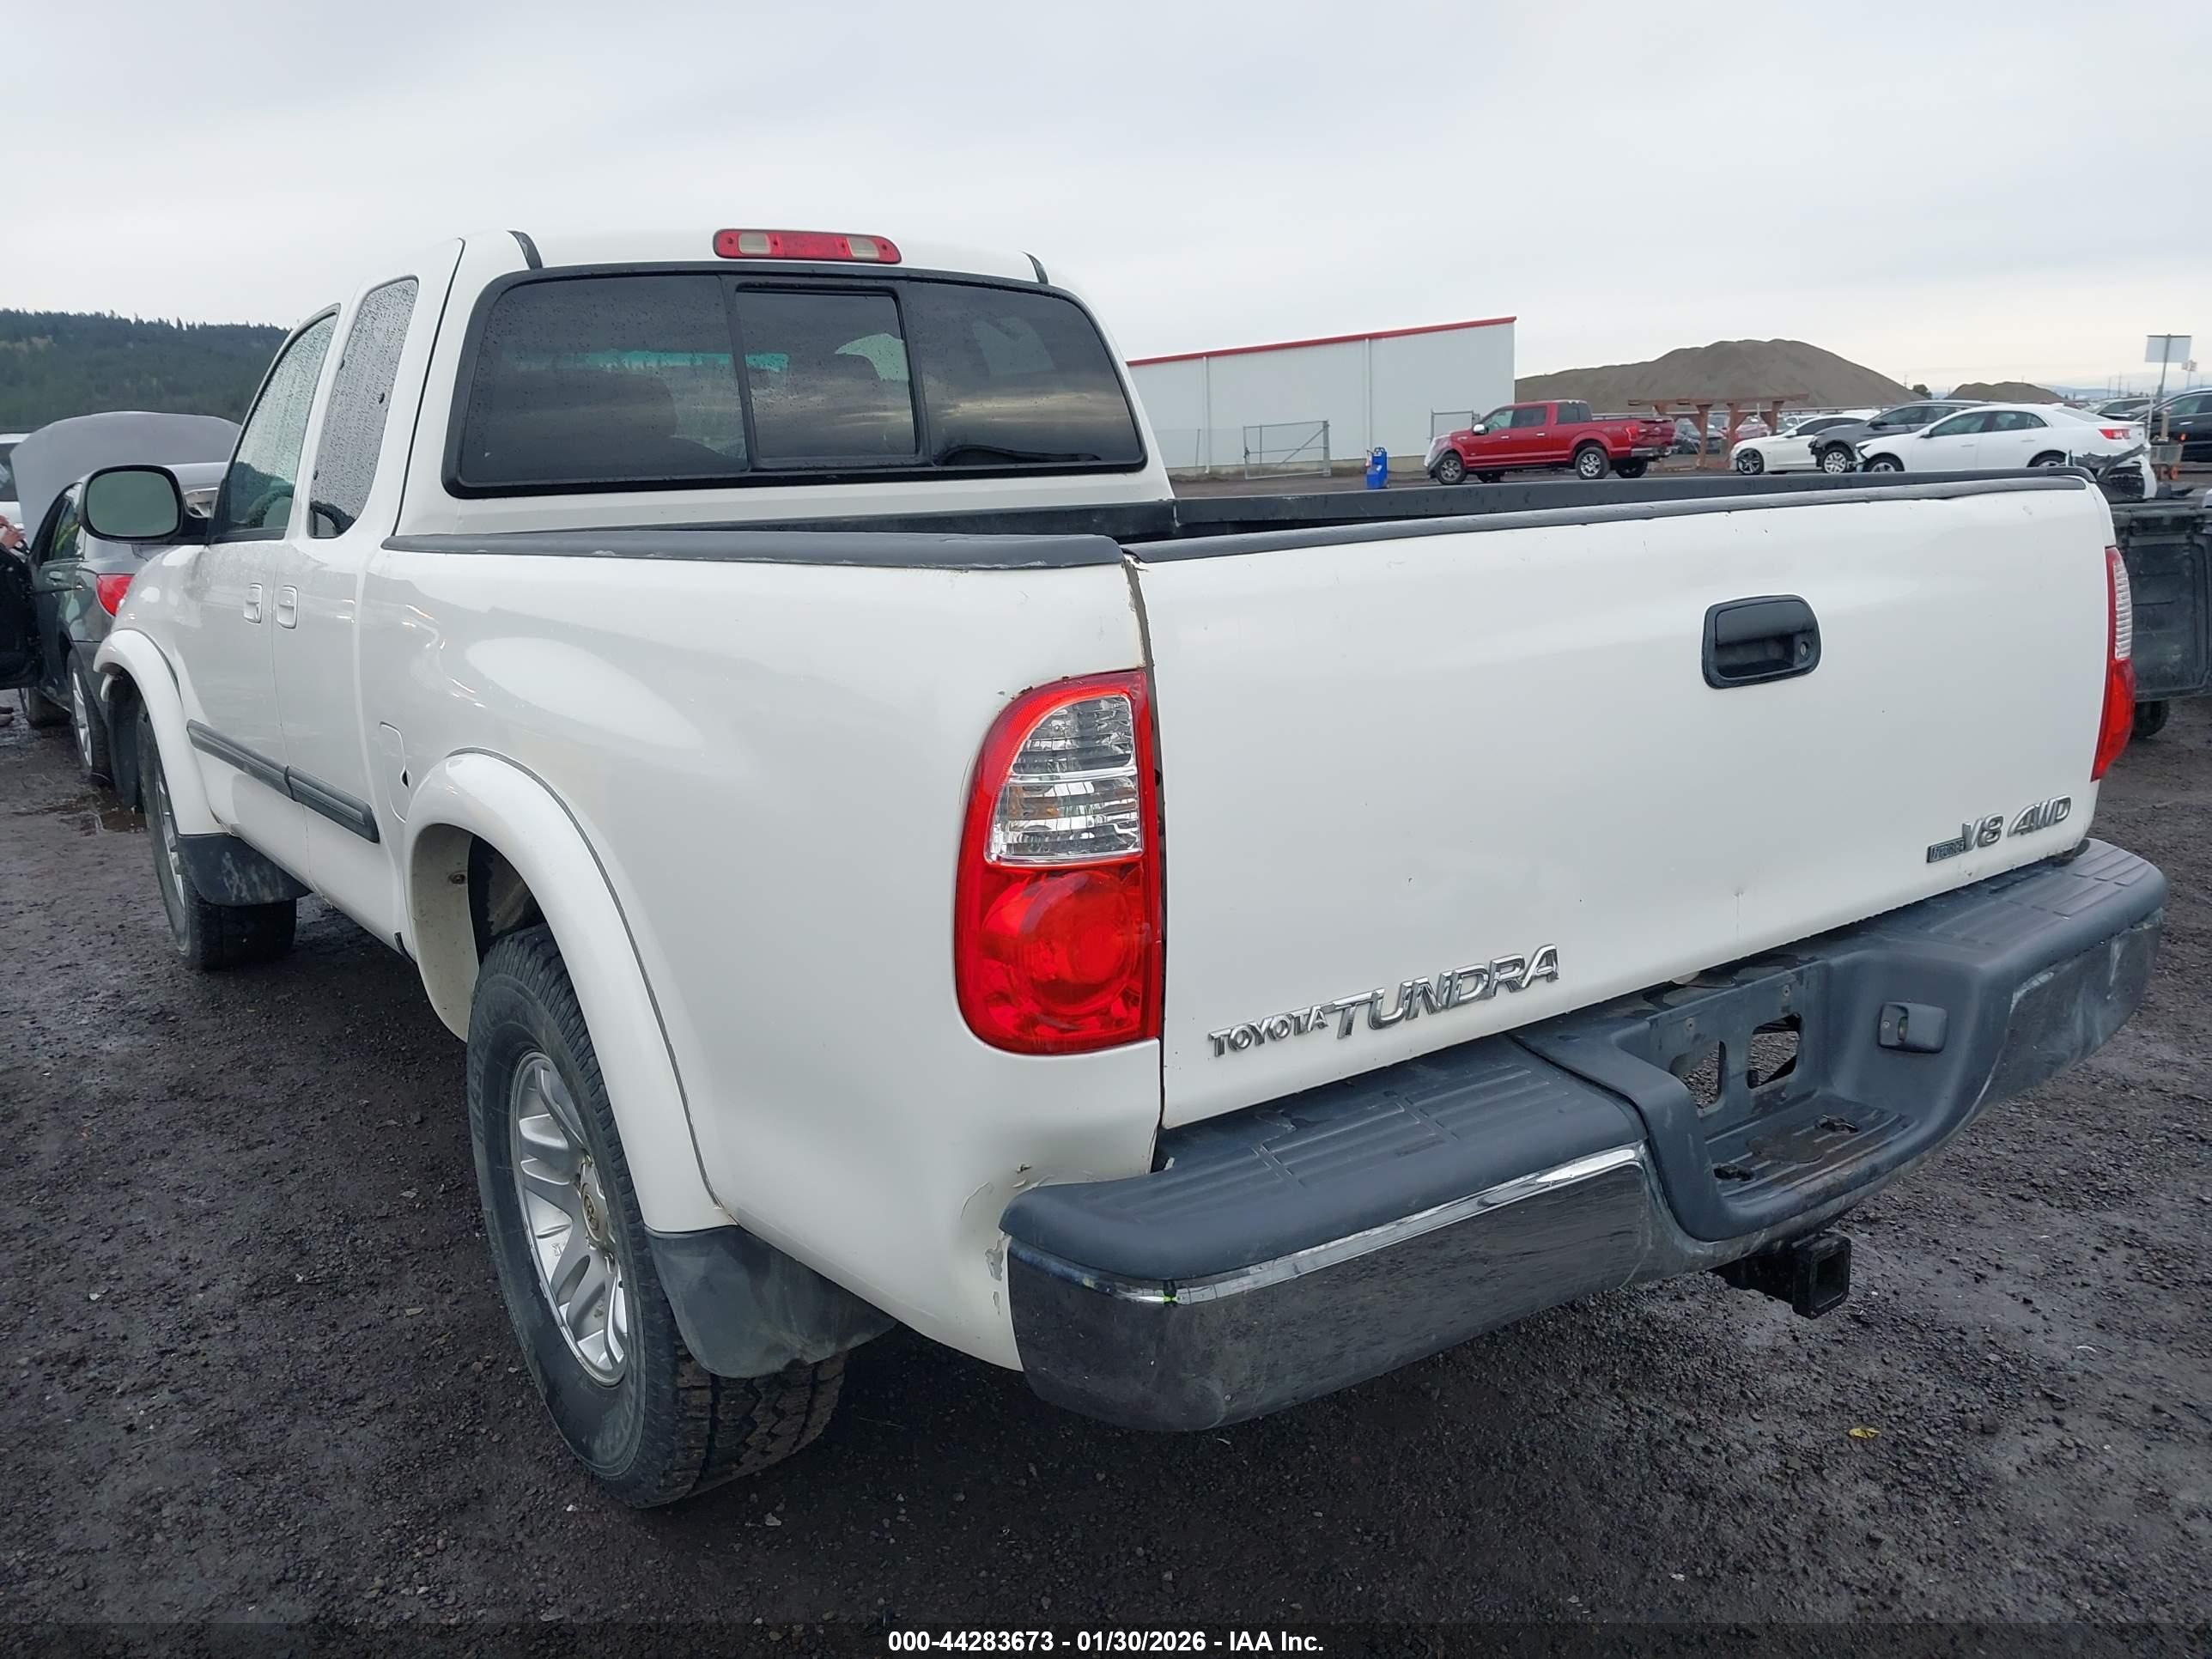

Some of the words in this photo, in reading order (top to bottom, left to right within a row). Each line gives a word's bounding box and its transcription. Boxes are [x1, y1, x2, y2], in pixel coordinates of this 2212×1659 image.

[1962, 812, 2003, 852] V8
[1208, 1005, 1329, 1057] TOYOTA
[1333, 944, 1559, 1039] TUNDRA
